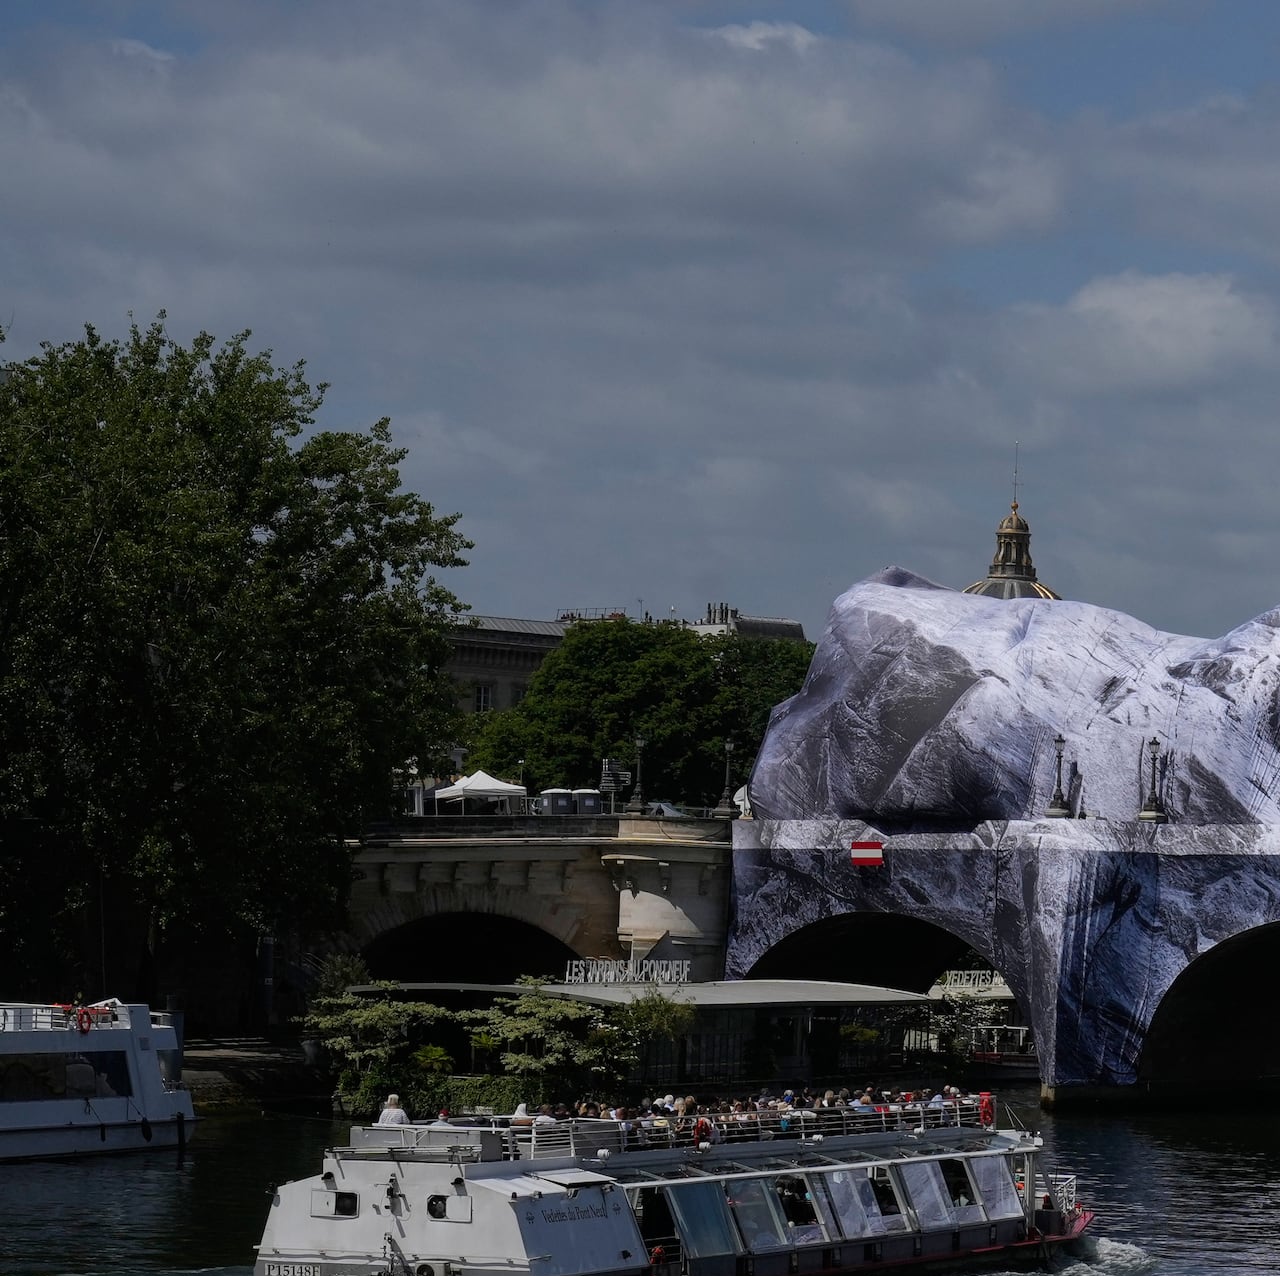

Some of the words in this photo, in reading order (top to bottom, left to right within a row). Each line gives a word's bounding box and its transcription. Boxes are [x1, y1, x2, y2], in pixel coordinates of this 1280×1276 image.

[565, 959, 585, 983] LES
[642, 959, 668, 982] PONT
[669, 959, 691, 982] NEUF
[944, 970, 992, 988] VEDETTES
[541, 1208, 568, 1223] Vedettes
[567, 1206, 576, 1221] du
[575, 1206, 591, 1220] Pont
